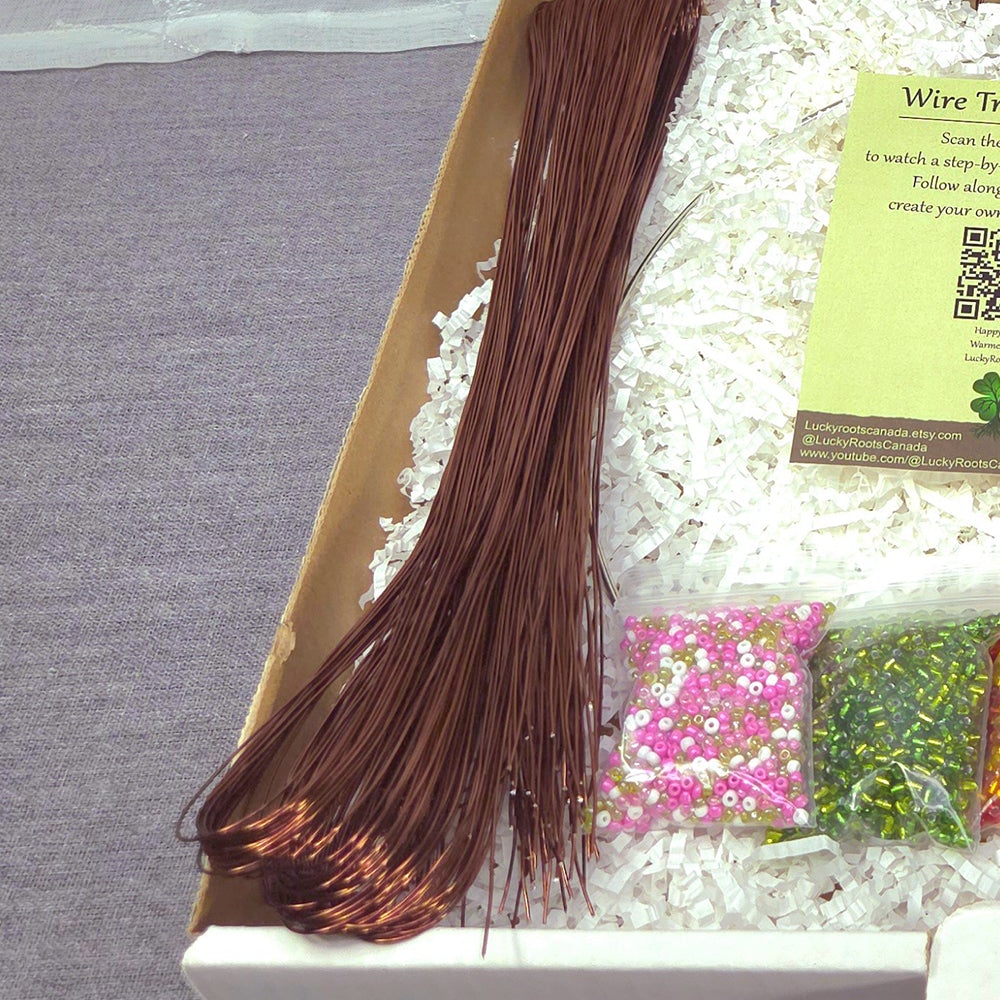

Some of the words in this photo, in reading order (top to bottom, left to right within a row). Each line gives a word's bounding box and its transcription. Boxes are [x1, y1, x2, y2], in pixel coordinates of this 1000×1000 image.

[901, 86, 968, 111] Wire
[940, 131, 976, 147] Scan
[865, 150, 880, 162] to
[882, 150, 926, 166] watch
[930, 157, 940, 167] a
[912, 174, 960, 192] Follow
[888, 200, 934, 214] create
[934, 205, 973, 219] your
[804, 420, 962, 441] Luckyrootscanada.etsy.com
[801, 434, 928, 453] @LuckyRootsCanada
